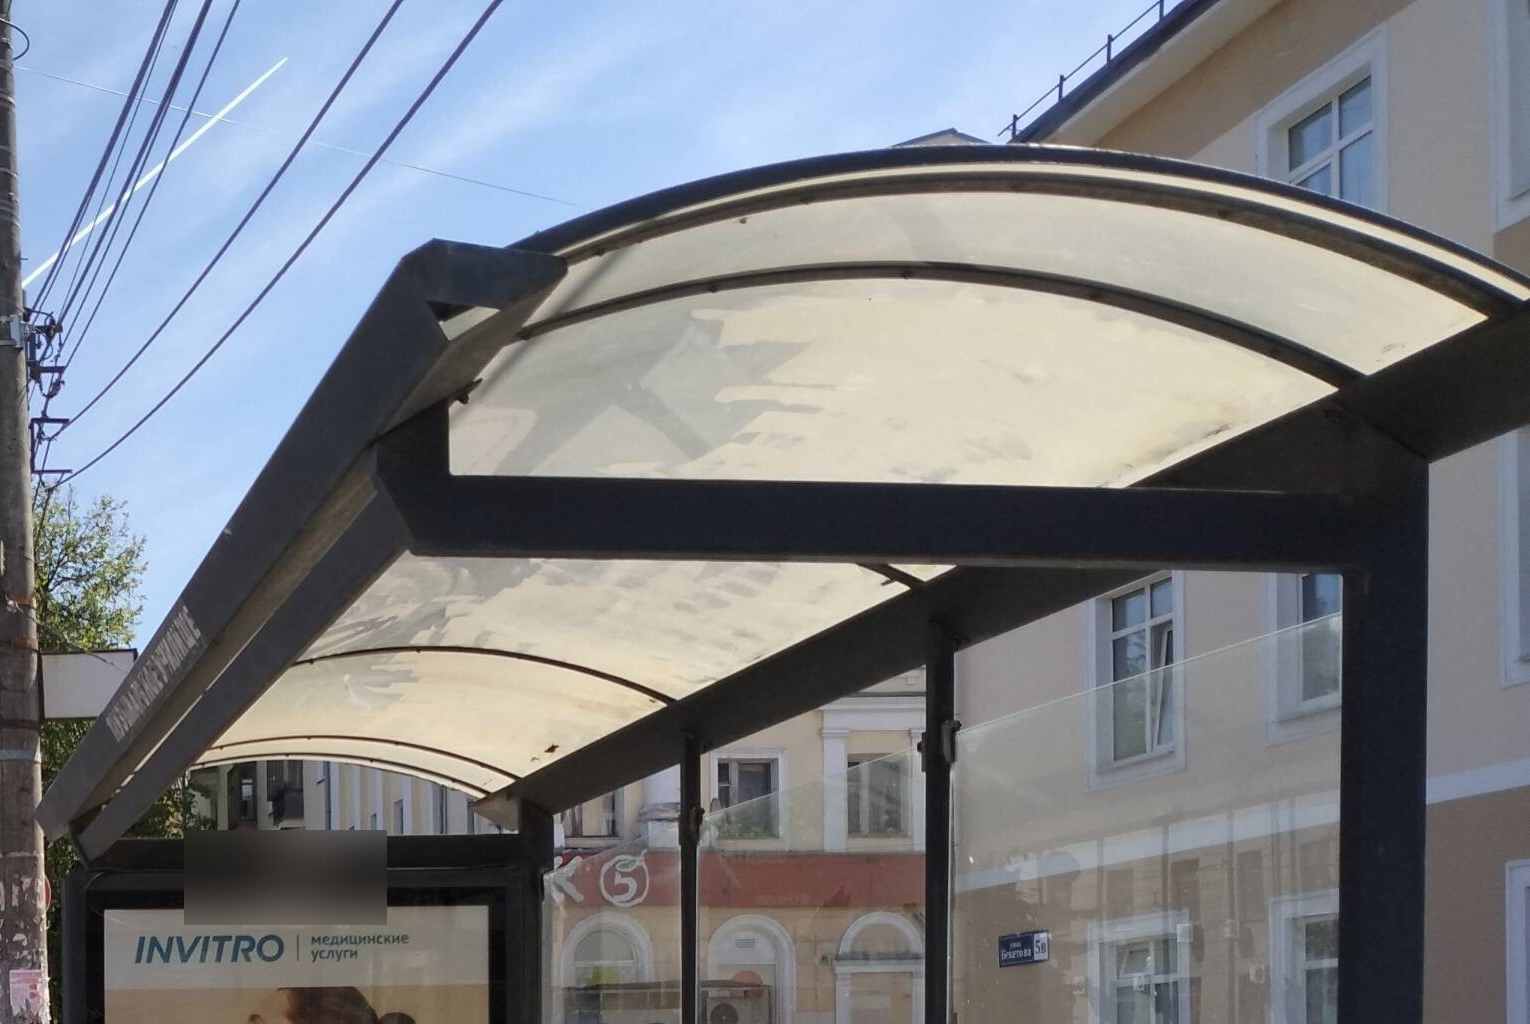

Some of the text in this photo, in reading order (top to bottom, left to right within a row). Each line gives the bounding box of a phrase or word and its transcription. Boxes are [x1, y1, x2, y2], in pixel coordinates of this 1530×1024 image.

[311, 933, 409, 946] медицинские
[134, 934, 284, 964] INVITRO
[311, 948, 358, 962] услуги
[1001, 948, 1032, 960] Бекетова
